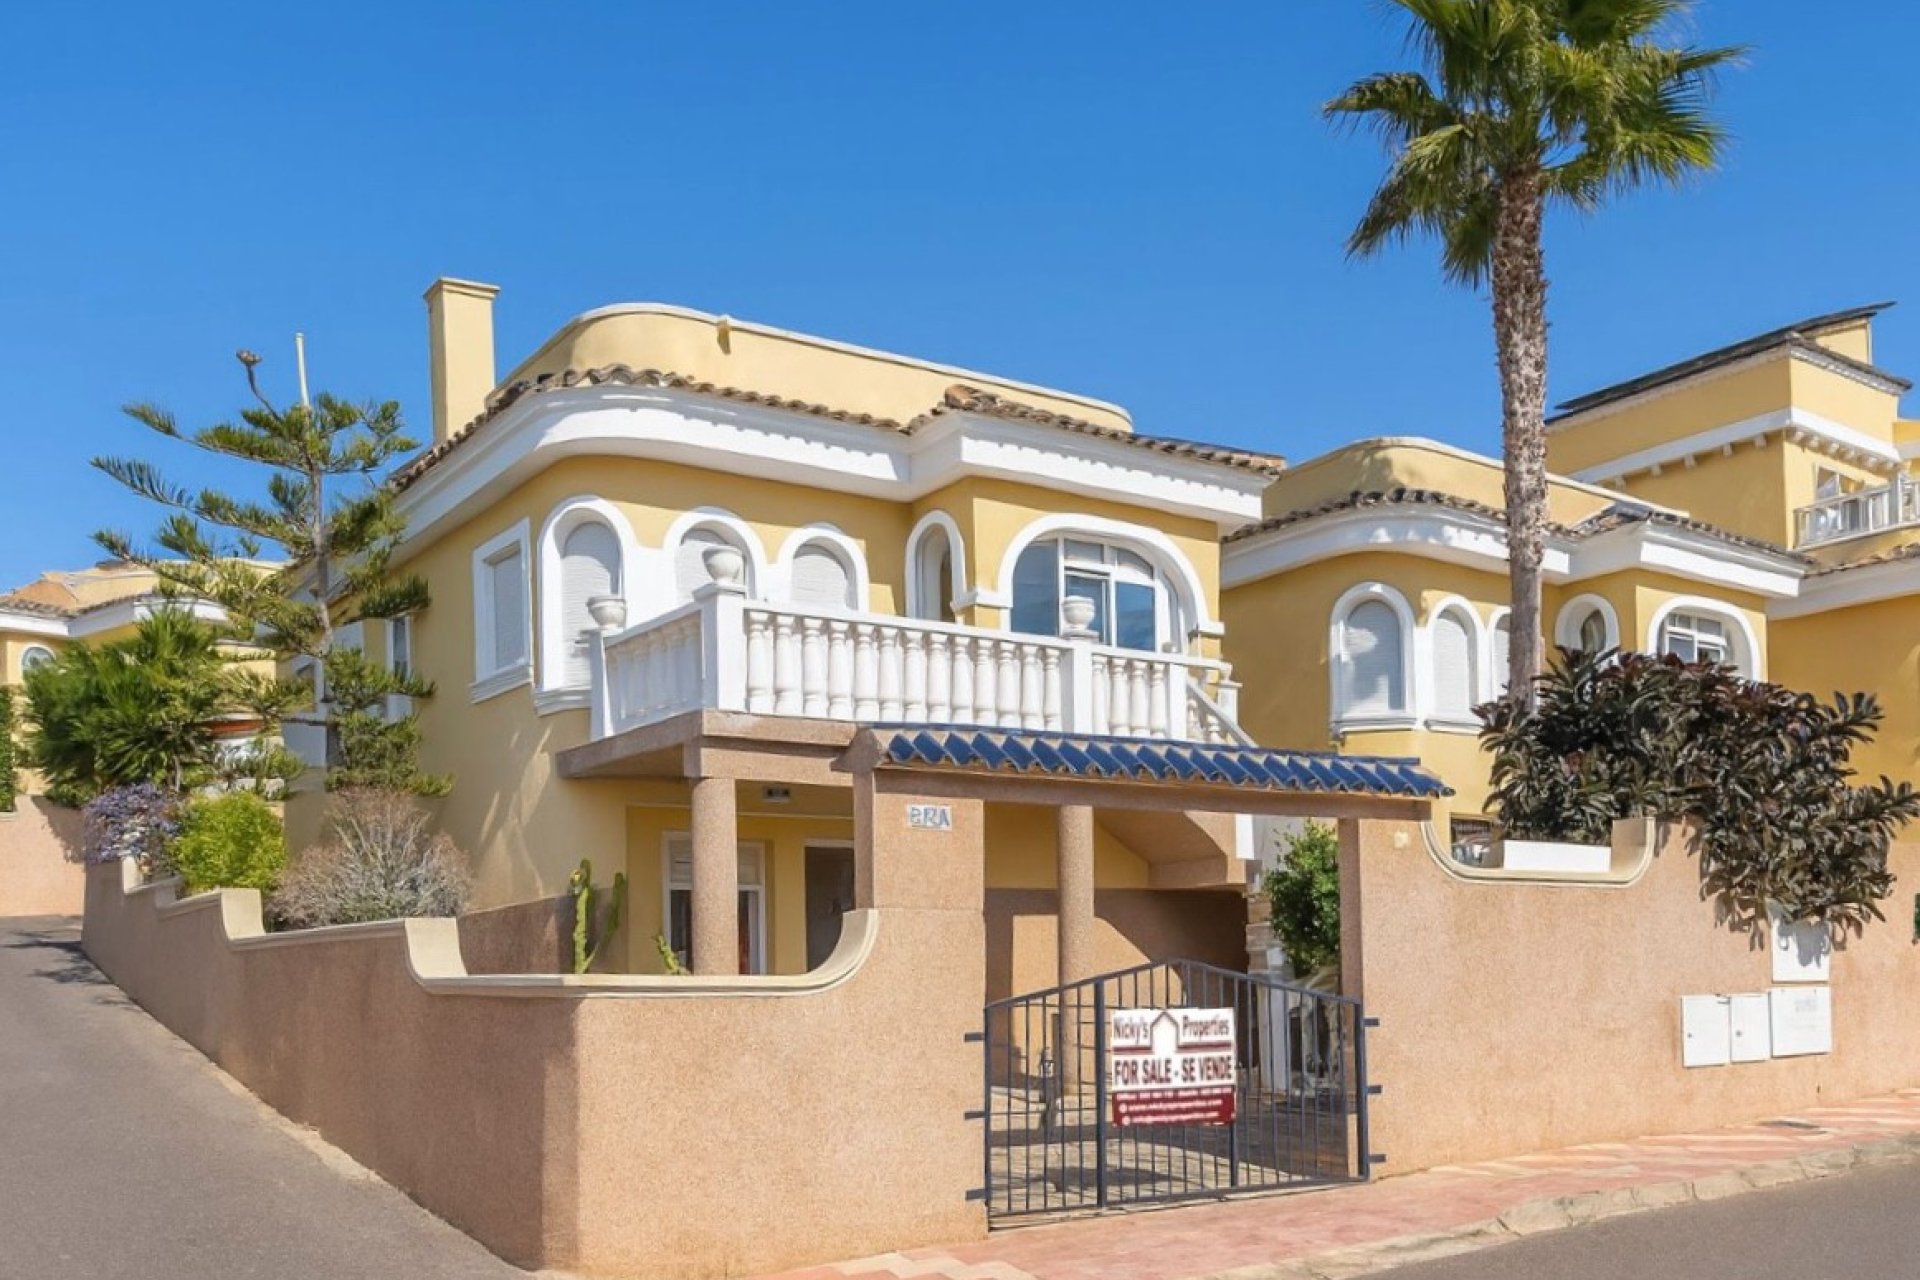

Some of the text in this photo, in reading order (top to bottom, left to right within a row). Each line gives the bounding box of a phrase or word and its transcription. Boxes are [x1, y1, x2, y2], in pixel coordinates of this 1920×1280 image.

[1114, 1014, 1229, 1043] Nicky's Properties
[1115, 1059, 1138, 1086] FOR
[1143, 1057, 1172, 1084] SALE
[1182, 1056, 1196, 1082] SE
[1198, 1054, 1232, 1081] VENDE
